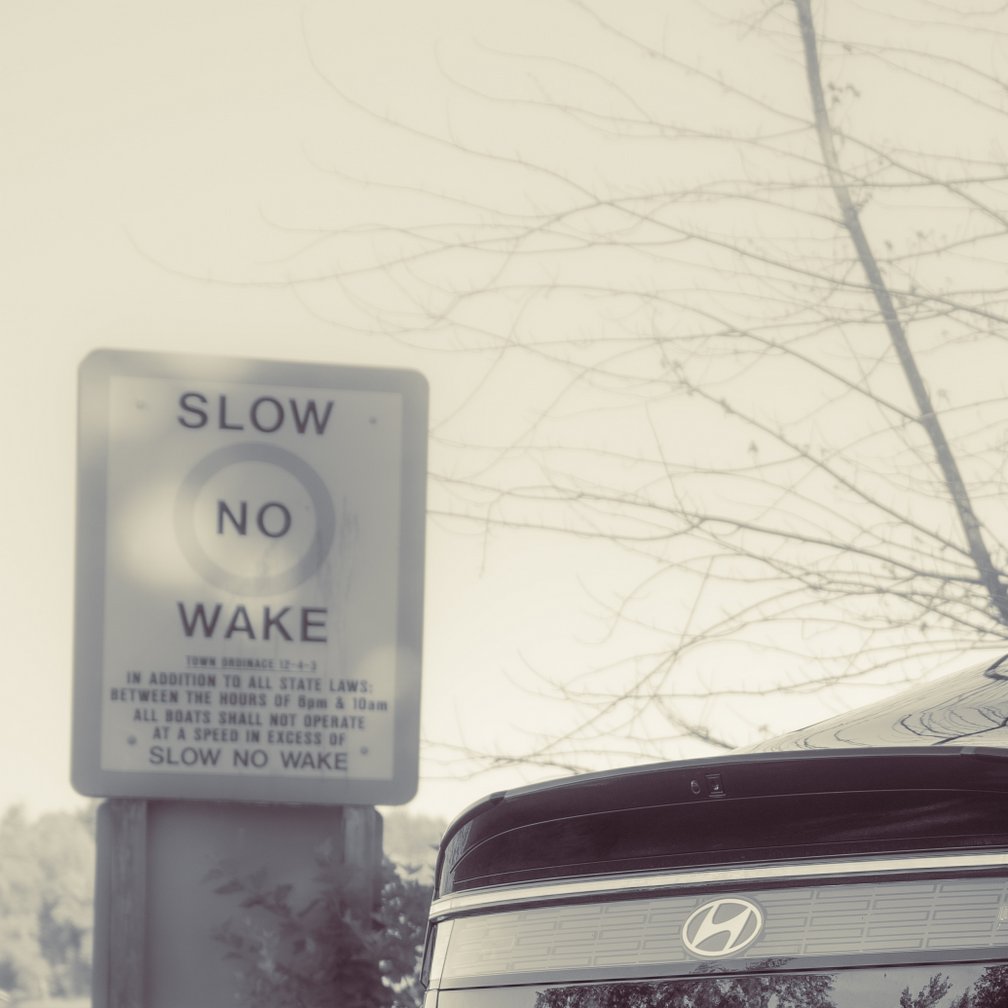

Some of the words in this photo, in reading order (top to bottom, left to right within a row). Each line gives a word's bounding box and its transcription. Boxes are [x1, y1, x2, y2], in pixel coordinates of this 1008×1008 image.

[177, 392, 334, 435] SLOW
[216, 500, 292, 538] NO
[177, 602, 328, 643] WAKE
[185, 655, 216, 666] TOWN
[126, 670, 141, 684] IN
[149, 671, 217, 687] ADDITION
[224, 673, 241, 688] TO
[248, 675, 272, 690] ALL
[279, 676, 321, 692] STATE
[329, 678, 373, 694] LAWS:
[110, 688, 178, 704] BETWEEN
[186, 690, 212, 705] THE
[219, 691, 266, 707] HOURS
[274, 693, 290, 707] OF
[335, 695, 345, 710] &
[353, 697, 388, 712] 10am
[133, 708, 157, 722] ALL
[165, 708, 211, 724] BOATS
[218, 711, 262, 726] SHALL
[269, 713, 296, 727] NOT
[303, 714, 365, 730] OPERATE
[152, 725, 170, 740] AT
[177, 726, 186, 740] A
[193, 727, 239, 742] SPEED
[246, 729, 260, 743] IN
[267, 730, 322, 745] EXCESS
[329, 732, 346, 746] OF
[149, 745, 221, 766] SLOW
[233, 748, 268, 768] NO
[280, 750, 348, 771] WAKE
